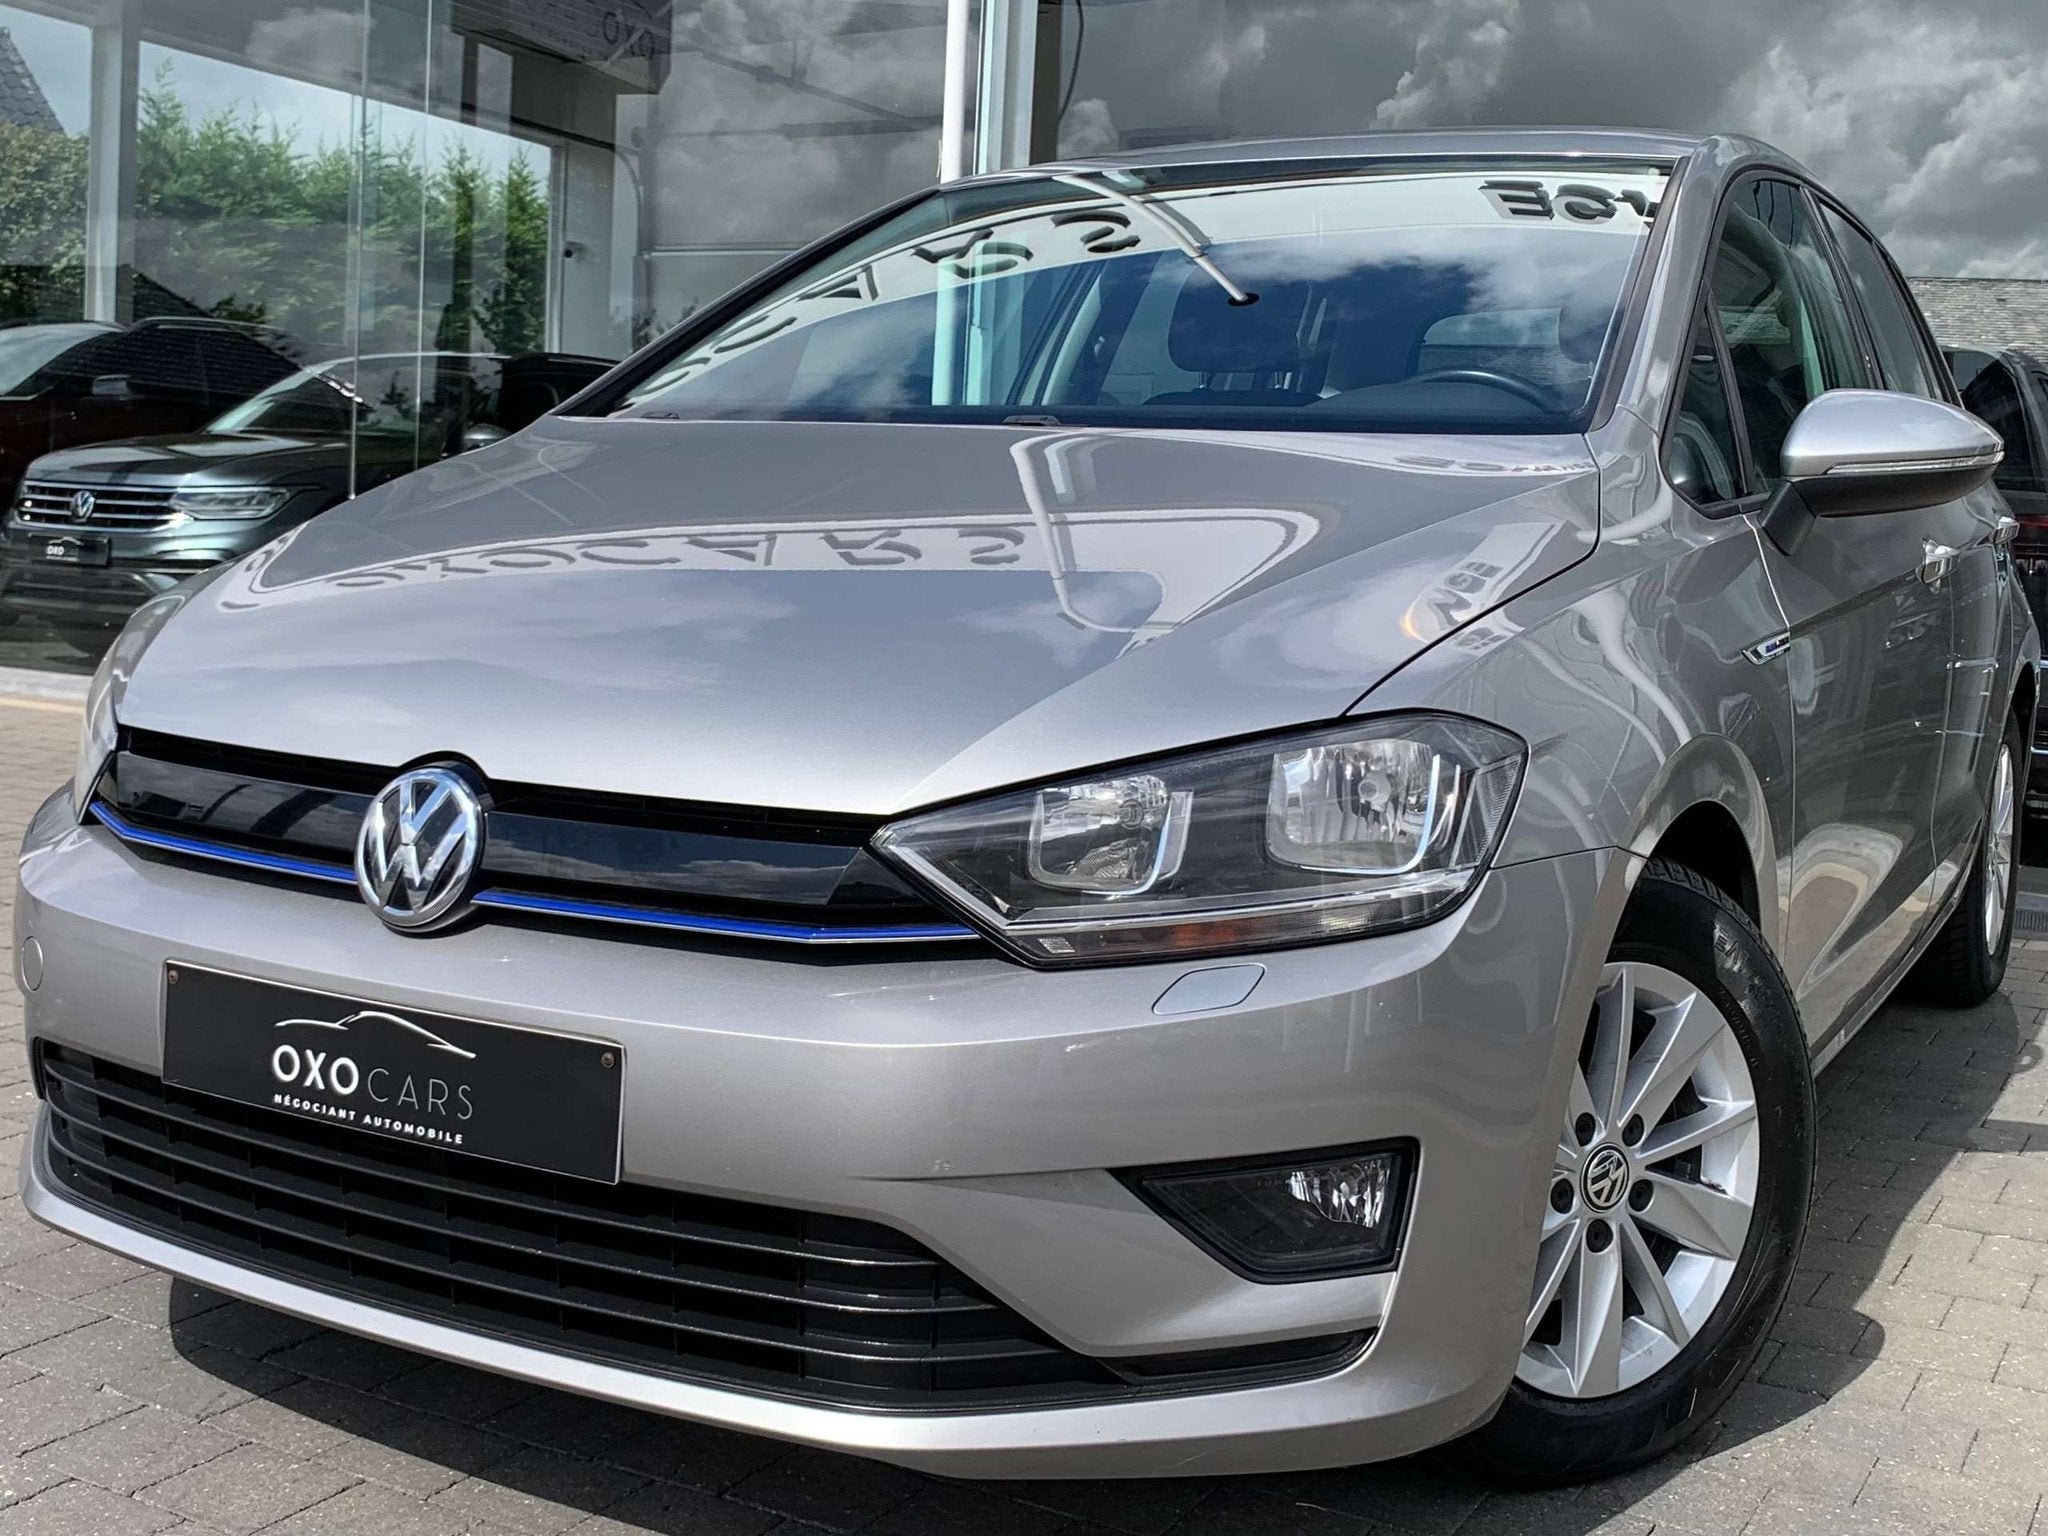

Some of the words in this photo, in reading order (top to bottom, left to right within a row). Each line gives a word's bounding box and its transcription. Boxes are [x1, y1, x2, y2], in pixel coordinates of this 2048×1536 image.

[358, 771, 475, 923] VW
[272, 1044, 359, 1095] OXO
[367, 1068, 473, 1120] CARS
[273, 1093, 357, 1121] NÉGOCIANT
[363, 1114, 463, 1144] AUTOMOBILE
